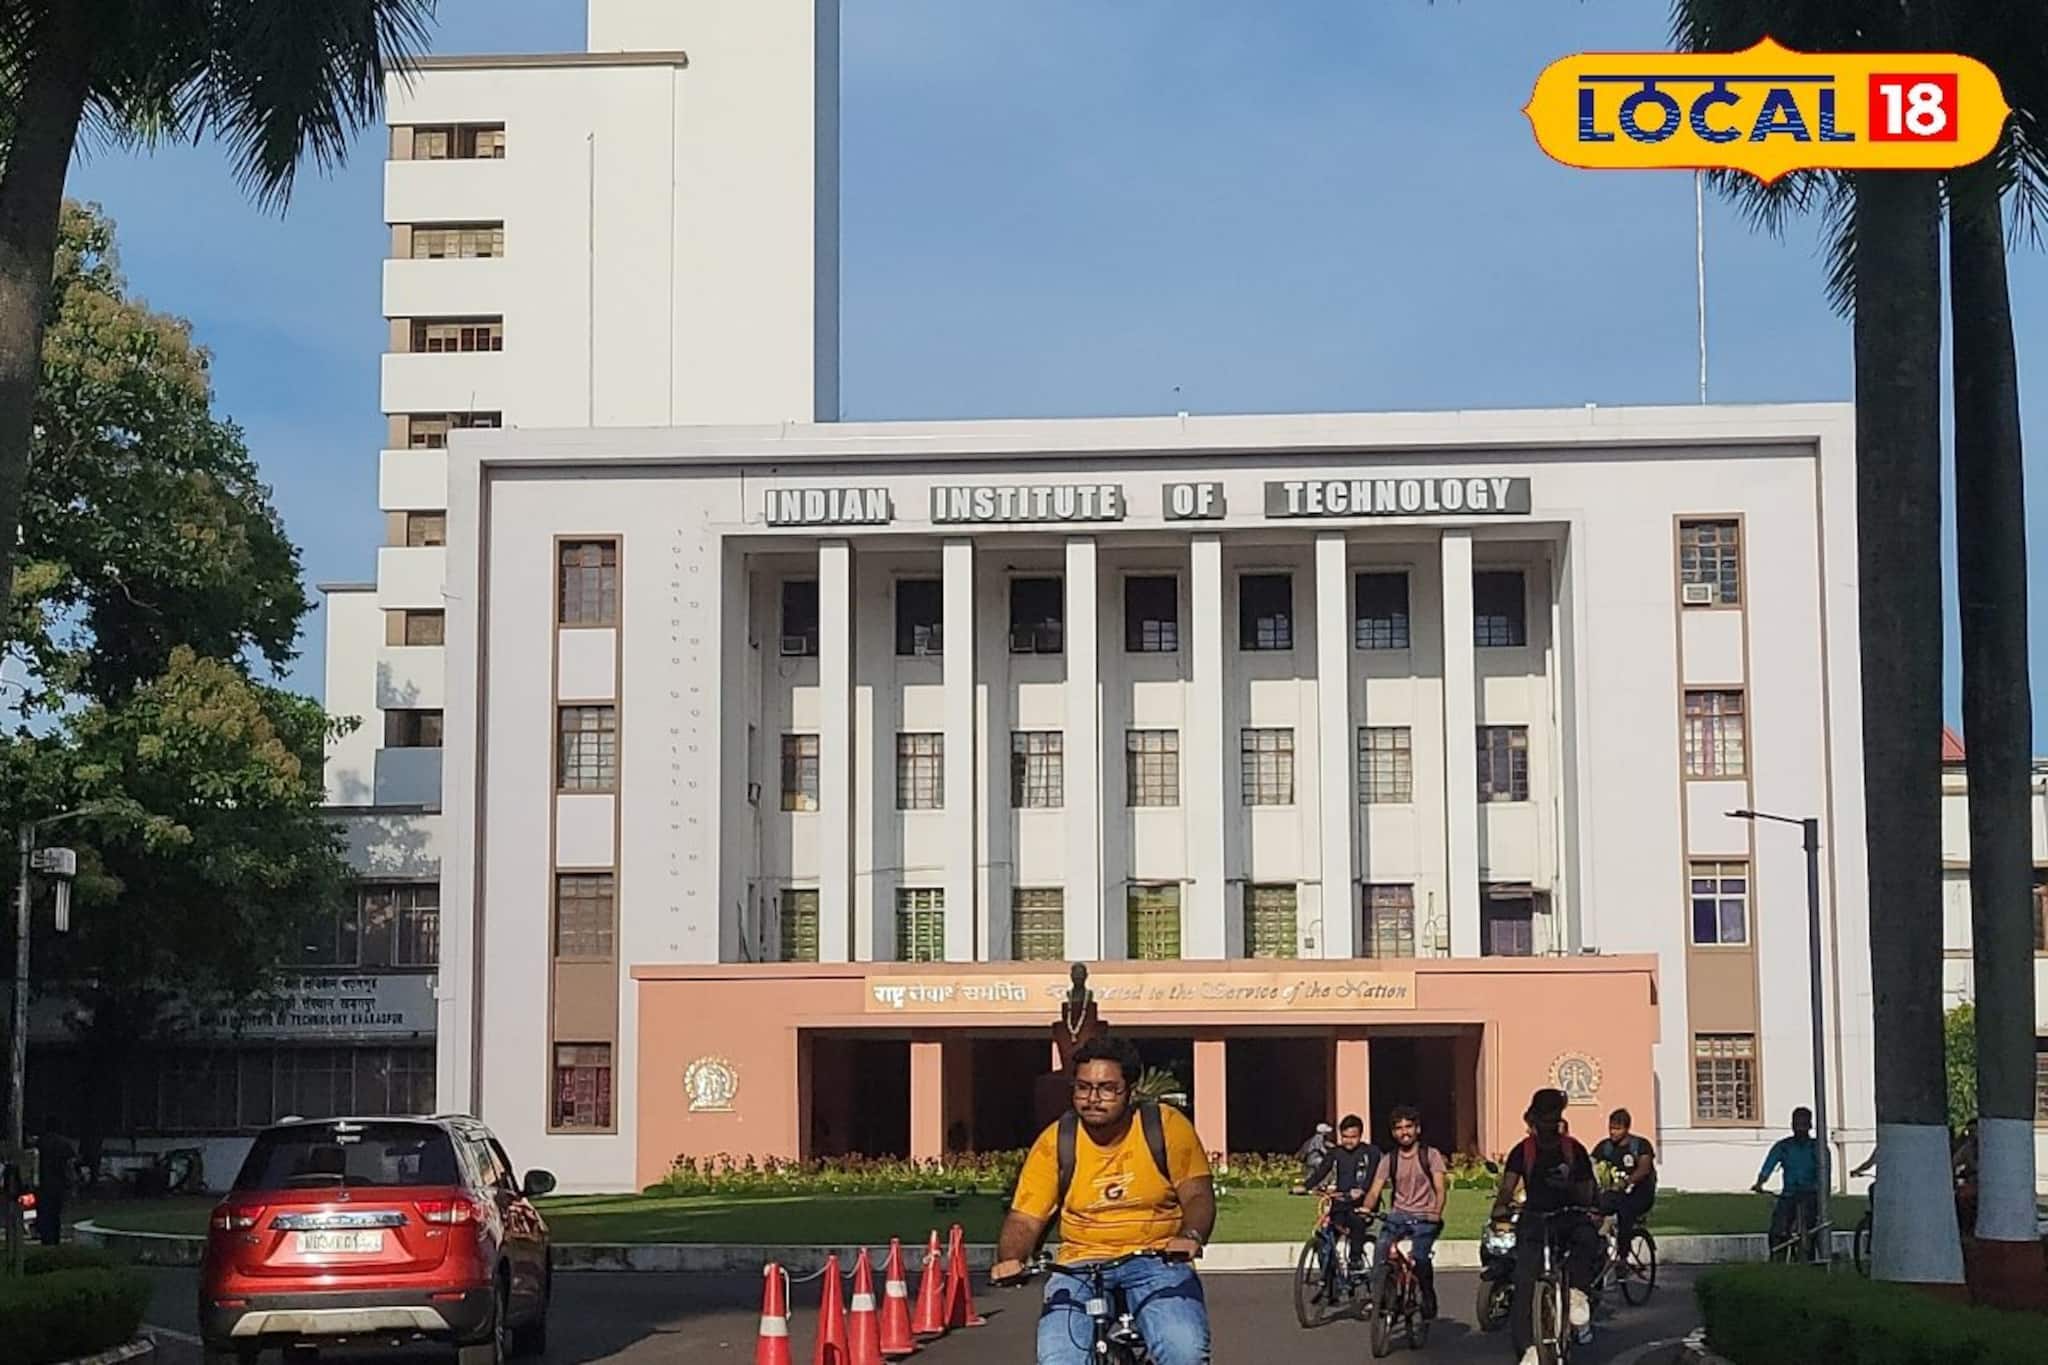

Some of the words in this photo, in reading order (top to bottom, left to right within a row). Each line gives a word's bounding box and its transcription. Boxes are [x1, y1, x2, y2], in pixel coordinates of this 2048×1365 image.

[766, 489, 889, 523] INDIAN
[935, 486, 1118, 519] INSTITUTE
[1172, 483, 1217, 515] OF
[1284, 478, 1512, 514] TECHNOLOGY
[1169, 982, 1195, 1000] the
[1201, 981, 1279, 1000] Service
[1281, 980, 1305, 1005] of
[1305, 980, 1330, 999] the
[1335, 978, 1408, 999] Nation
[1104, 1182, 1124, 1201] G
